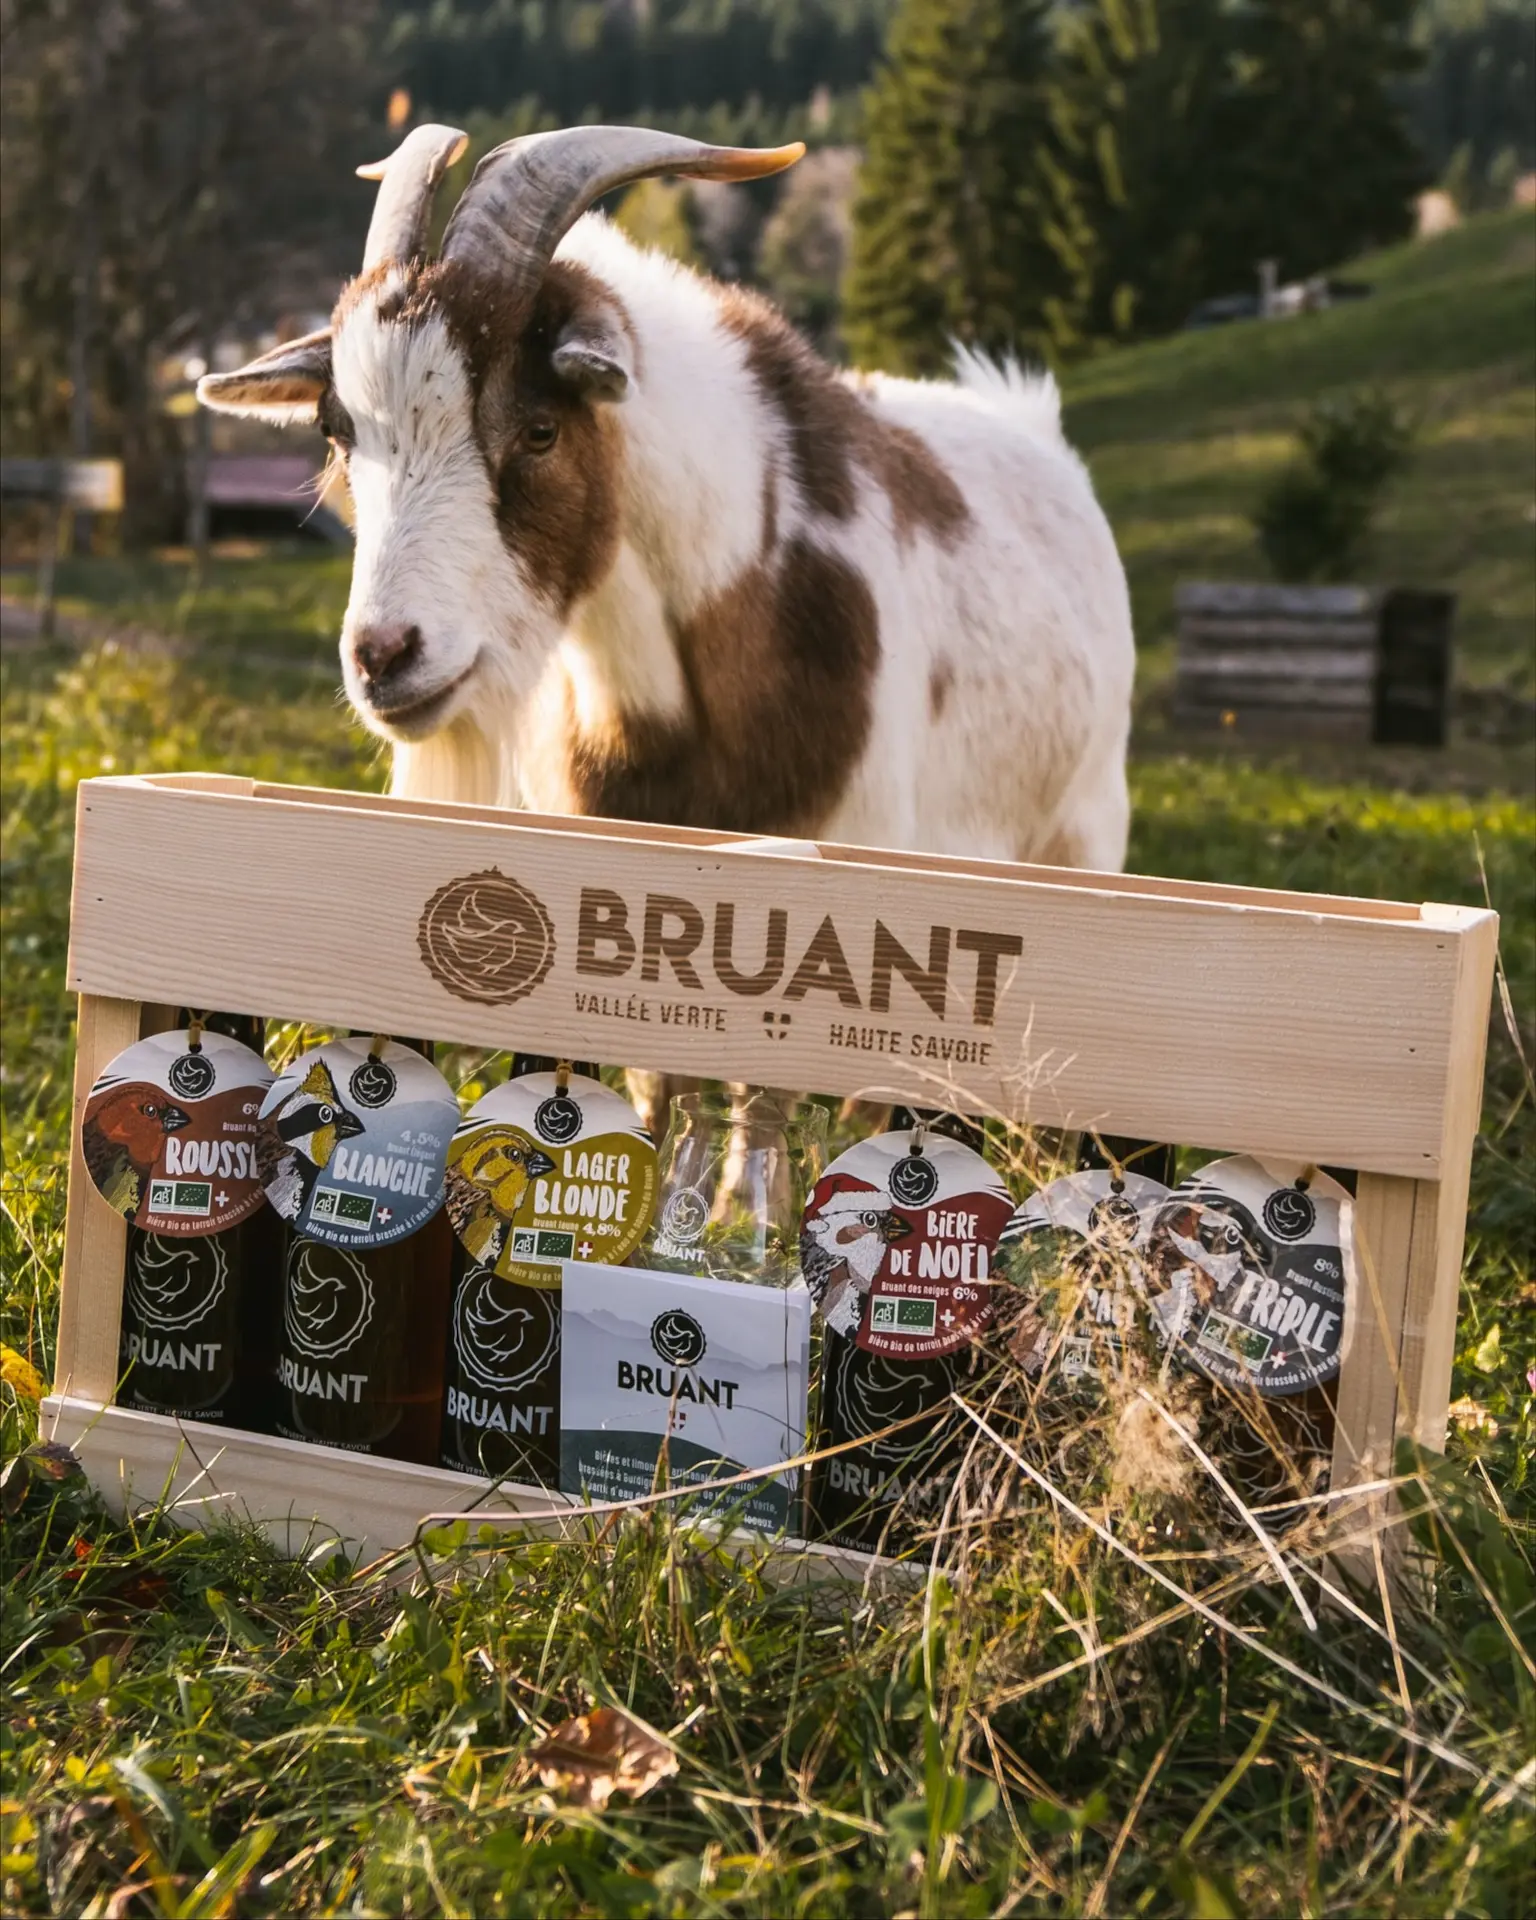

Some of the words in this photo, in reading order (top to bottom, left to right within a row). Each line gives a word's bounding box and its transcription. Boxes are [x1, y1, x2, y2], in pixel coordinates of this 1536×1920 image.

[576, 887, 1023, 1026] BRUANT
[575, 992, 650, 1023] VALLÉE
[660, 1002, 727, 1032] VERTE
[830, 1023, 902, 1055] HAUTE
[911, 1033, 994, 1066] SAVOIE
[333, 1146, 436, 1198] BLANCHE
[563, 1150, 631, 1184] LAGER
[153, 1190, 169, 1204] AB
[315, 1198, 332, 1213] AB
[534, 1178, 631, 1221] BLONDE
[181, 1221, 191, 1231] de
[305, 1222, 325, 1238] Bière
[325, 1230, 337, 1241] Bio
[339, 1233, 349, 1243] de
[351, 1233, 375, 1244] terroir
[376, 1223, 406, 1241] brassée
[582, 1222, 621, 1237] 4,8%
[515, 1238, 531, 1253] AB
[890, 1248, 913, 1276] DE
[1313, 1258, 1339, 1279] 8%
[881, 1281, 906, 1293] Bruant
[908, 1284, 922, 1294] des
[923, 1285, 949, 1298] neiges
[953, 1286, 978, 1301] 6%
[875, 1306, 892, 1322] AB
[868, 1334, 888, 1349] Bière
[890, 1340, 902, 1352] Bio
[904, 1342, 915, 1352] de
[916, 1339, 942, 1352] terroir
[617, 1360, 739, 1410] BRUANT
[447, 1385, 554, 1436] BRUANT
[621, 1458, 631, 1467] et
[616, 1469, 622, 1482] à
